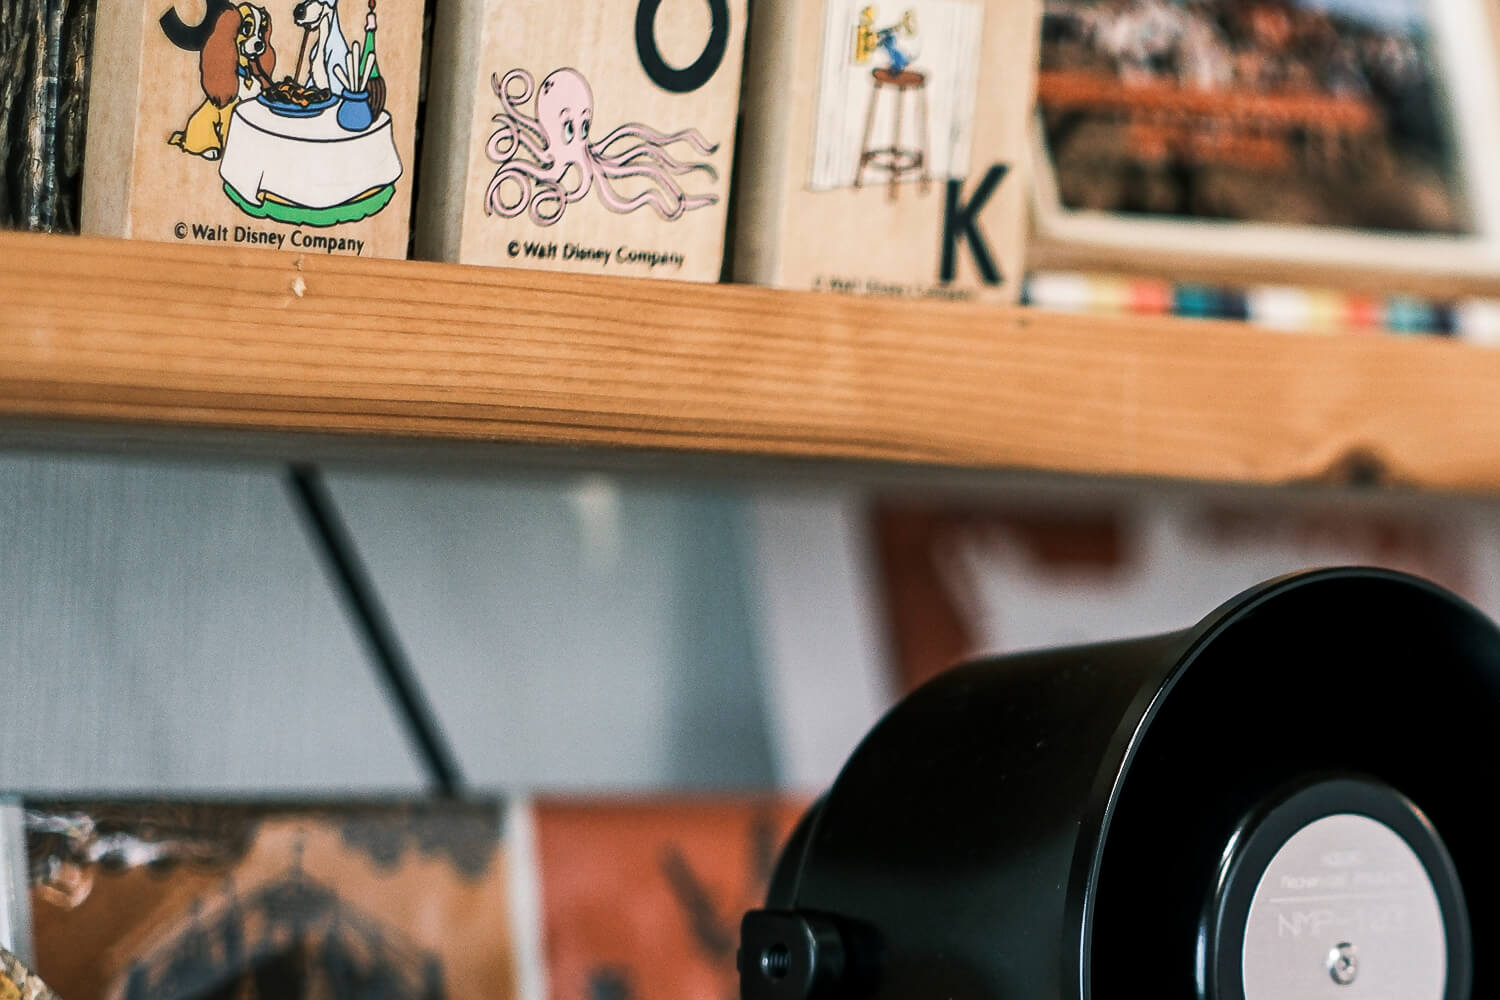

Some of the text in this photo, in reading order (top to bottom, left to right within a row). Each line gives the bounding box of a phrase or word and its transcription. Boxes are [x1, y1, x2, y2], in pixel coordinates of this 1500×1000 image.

[192, 223, 229, 242] Walt
[234, 226, 286, 250] Disney
[290, 230, 365, 257] Company
[939, 164, 1009, 286] K
[523, 240, 557, 260] Walt
[561, 243, 611, 268] Disney
[614, 246, 686, 272] Company
